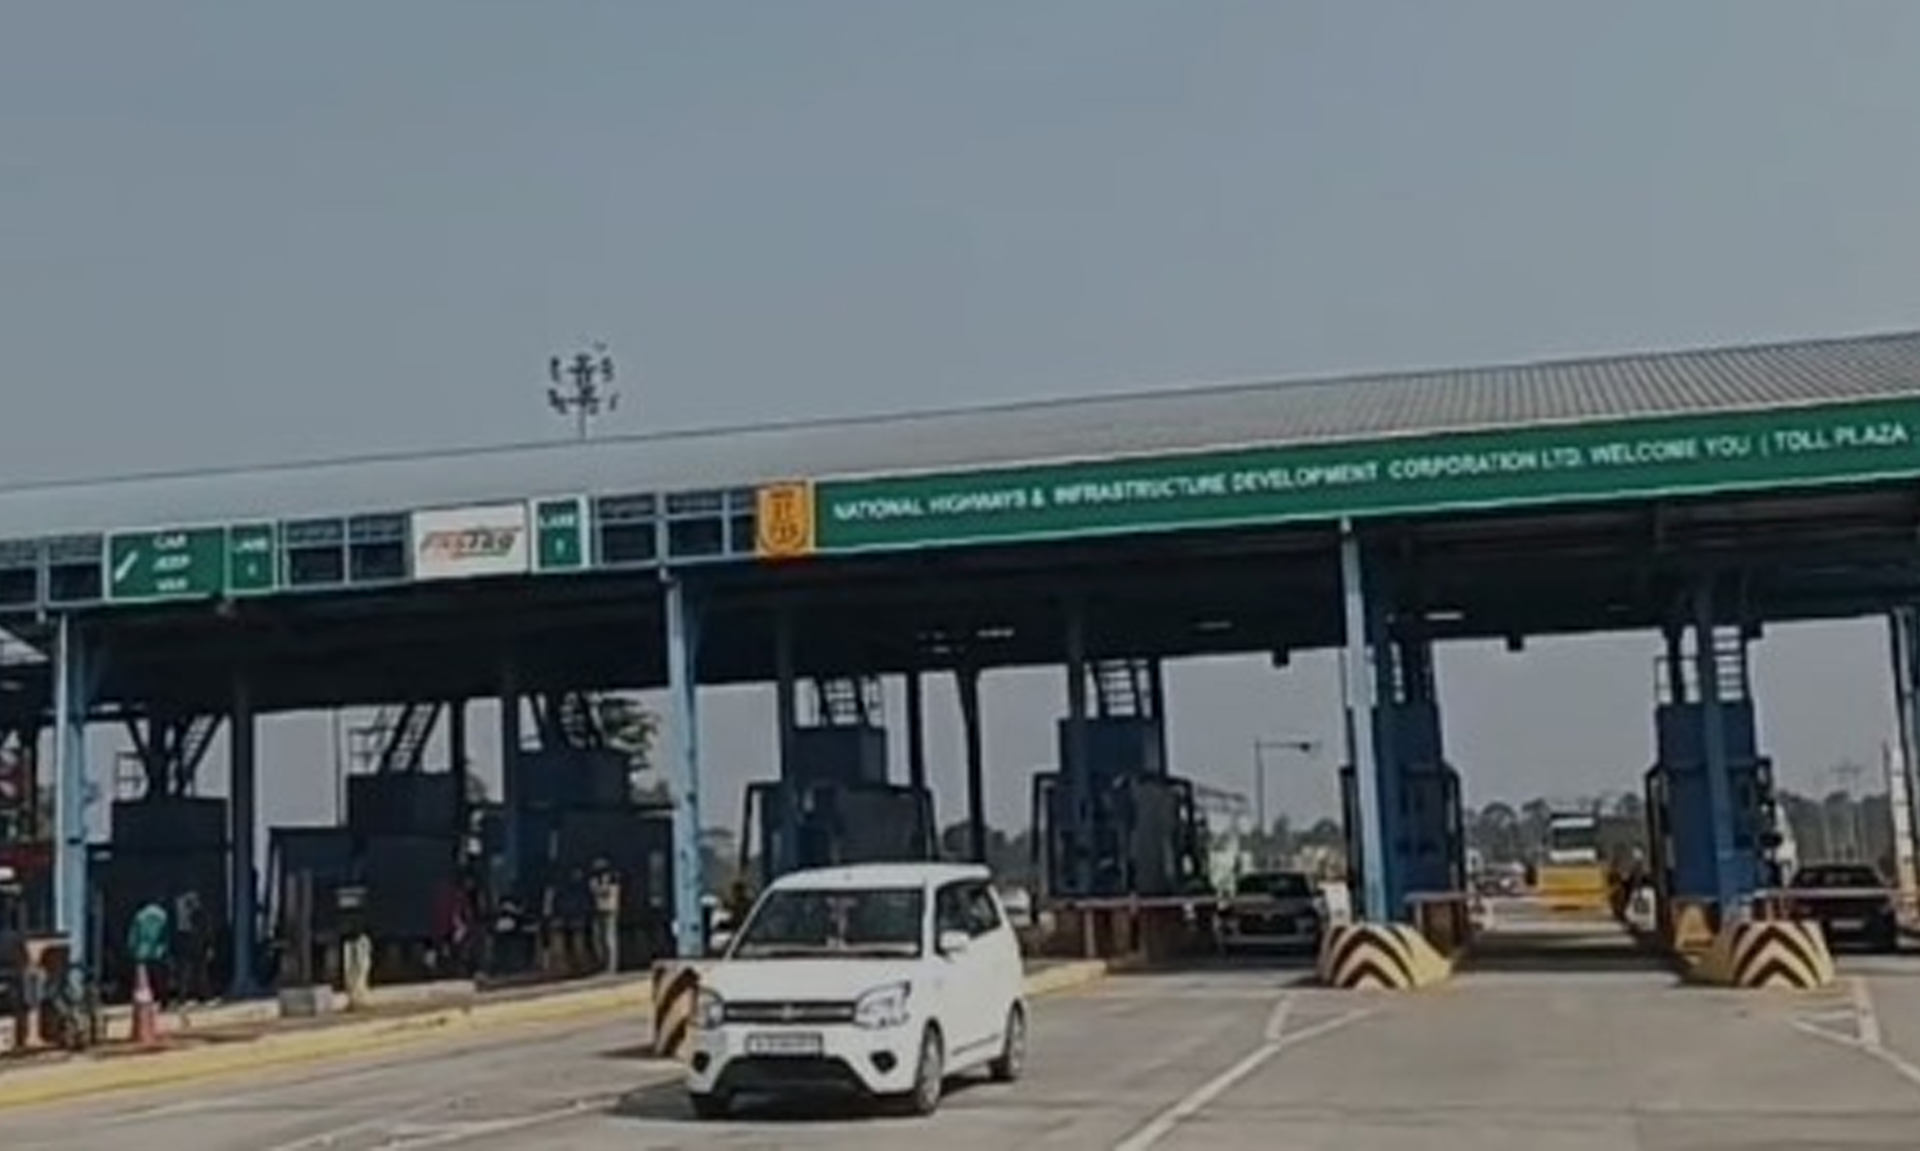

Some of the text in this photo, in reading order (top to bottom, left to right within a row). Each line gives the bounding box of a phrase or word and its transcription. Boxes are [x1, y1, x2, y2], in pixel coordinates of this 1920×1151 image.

[833, 497, 923, 520] NATIONAL
[928, 488, 1026, 514] HIGHWAYS
[1031, 487, 1045, 507] &
[1053, 470, 1227, 505] INFRASTRUCTURE
[1233, 461, 1378, 492] DEVELOPMENT
[1388, 451, 1537, 479] CORPORATION
[1590, 436, 1697, 464] WELCOME
[1704, 434, 1751, 457] YOU
[1834, 420, 1908, 446] PLAZA
